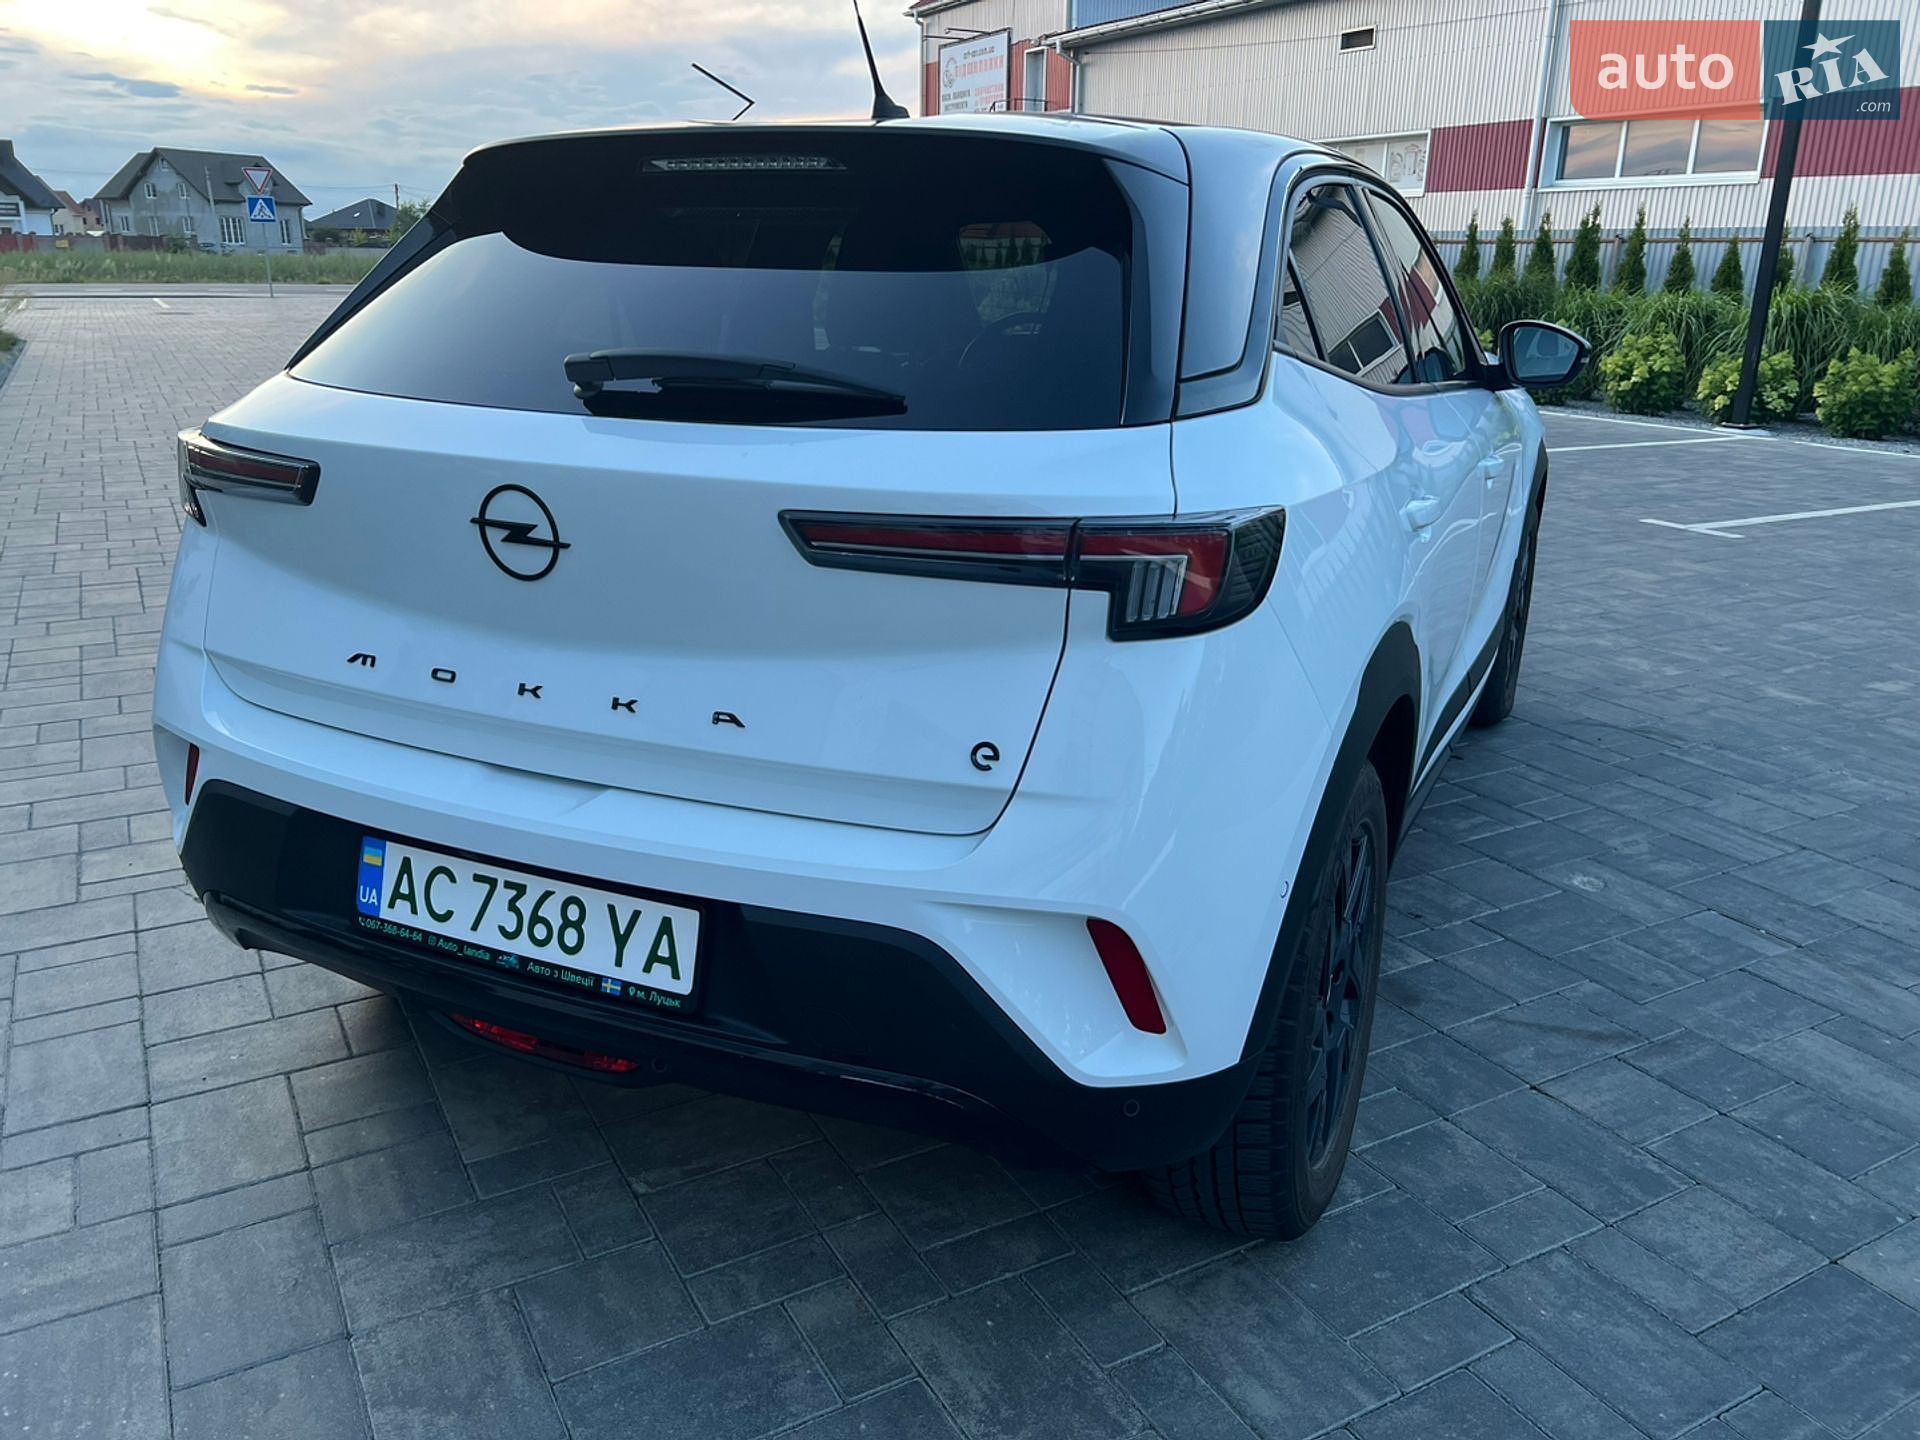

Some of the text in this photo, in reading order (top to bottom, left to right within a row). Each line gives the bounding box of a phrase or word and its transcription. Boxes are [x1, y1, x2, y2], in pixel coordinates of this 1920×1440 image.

[347, 652, 746, 728] MOKKA
[970, 741, 1000, 771] e
[359, 885, 378, 906] UA
[387, 856, 681, 980] AC 7368 YA
[527, 962, 551, 977] Авто
